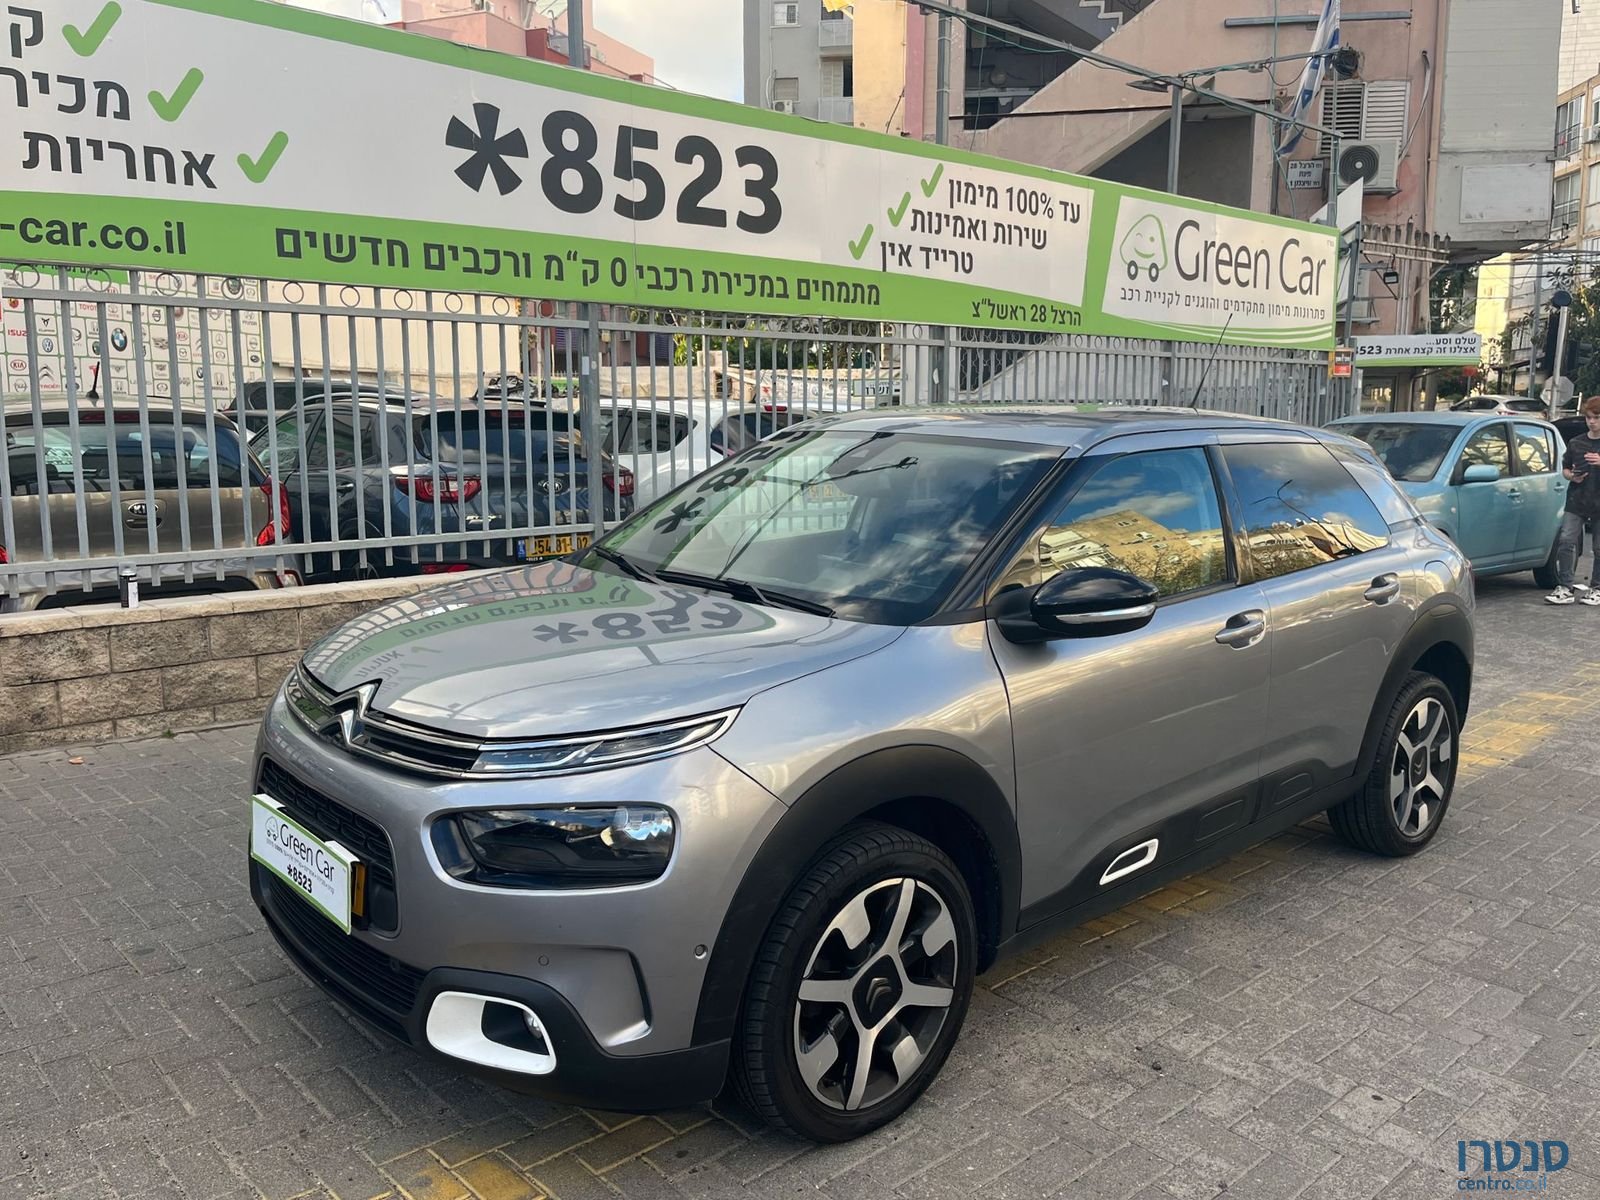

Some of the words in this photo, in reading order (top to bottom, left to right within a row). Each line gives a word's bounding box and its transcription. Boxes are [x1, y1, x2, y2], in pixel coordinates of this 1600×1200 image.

[22, 131, 218, 189] אחריות
[949, 179, 998, 209] מימון
[1005, 187, 1054, 219] 100%
[1059, 200, 1081, 223] עד
[0, 217, 187, 255] -car.co.il
[911, 209, 986, 241] ואמינות
[993, 222, 1047, 249] שירות
[275, 227, 410, 269] חדשים
[424, 241, 531, 279] ורכבים
[880, 240, 912, 272] אין
[919, 246, 974, 274] טרייד
[1174, 220, 1270, 290] Green
[1279, 238, 1327, 296] Car
[610, 257, 627, 287] 0
[636, 265, 693, 293] רכבי
[702, 269, 790, 300] במכירת
[796, 278, 881, 306] מתמחים
[1120, 286, 1141, 302] רכב
[1144, 289, 1181, 308] לקניית
[1184, 293, 1220, 309] והוגנים
[79, 303, 97, 311] TOYOT
[1030, 306, 1046, 322] 28
[1050, 305, 1082, 326] הרצל
[1223, 297, 1265, 317] מתקדמים
[1268, 304, 1291, 318] מימון
[1293, 308, 1325, 320] פתרונות
[7, 329, 28, 337] ISUZ
[1454, 336, 1476, 346] שלם
[1386, 347, 1411, 355] אחרת
[1412, 346, 1434, 356] קצת
[1436, 346, 1446, 354] זה
[1449, 345, 1476, 354] אצלנו
[280, 823, 314, 867] Green
[315, 850, 335, 882] Car
